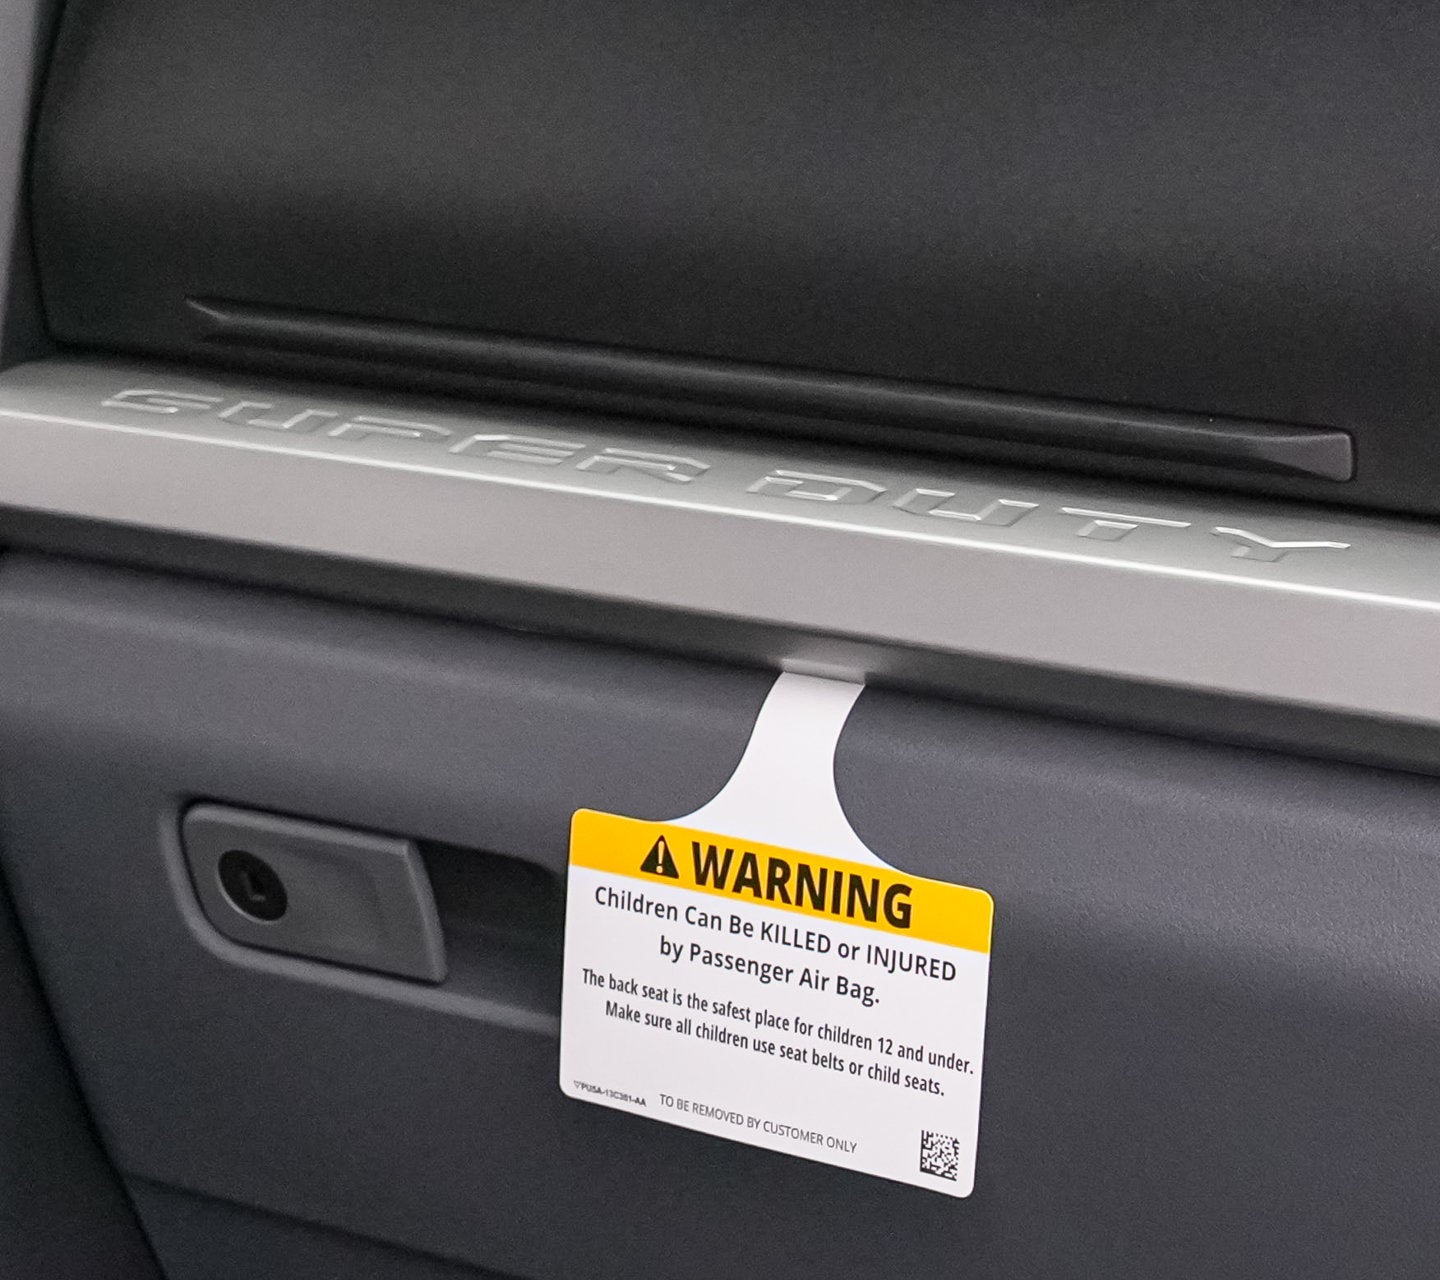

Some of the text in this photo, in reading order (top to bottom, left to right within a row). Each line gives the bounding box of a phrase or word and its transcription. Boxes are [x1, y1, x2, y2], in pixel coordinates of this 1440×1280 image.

[101, 388, 1351, 563] SUPER DUTY
[692, 841, 912, 929] WARNING
[595, 886, 957, 981] Children Can Be KILLED or INJURED
[660, 934, 880, 1008] by Passenger Air Bag.
[582, 967, 974, 1075] The back seat is the safest place for children 12 and under.
[605, 1000, 945, 1097] Make sure all children use seat belts or child seats.
[659, 1093, 858, 1154] TO BE REMOVED BY CUSTOMER ONLY
